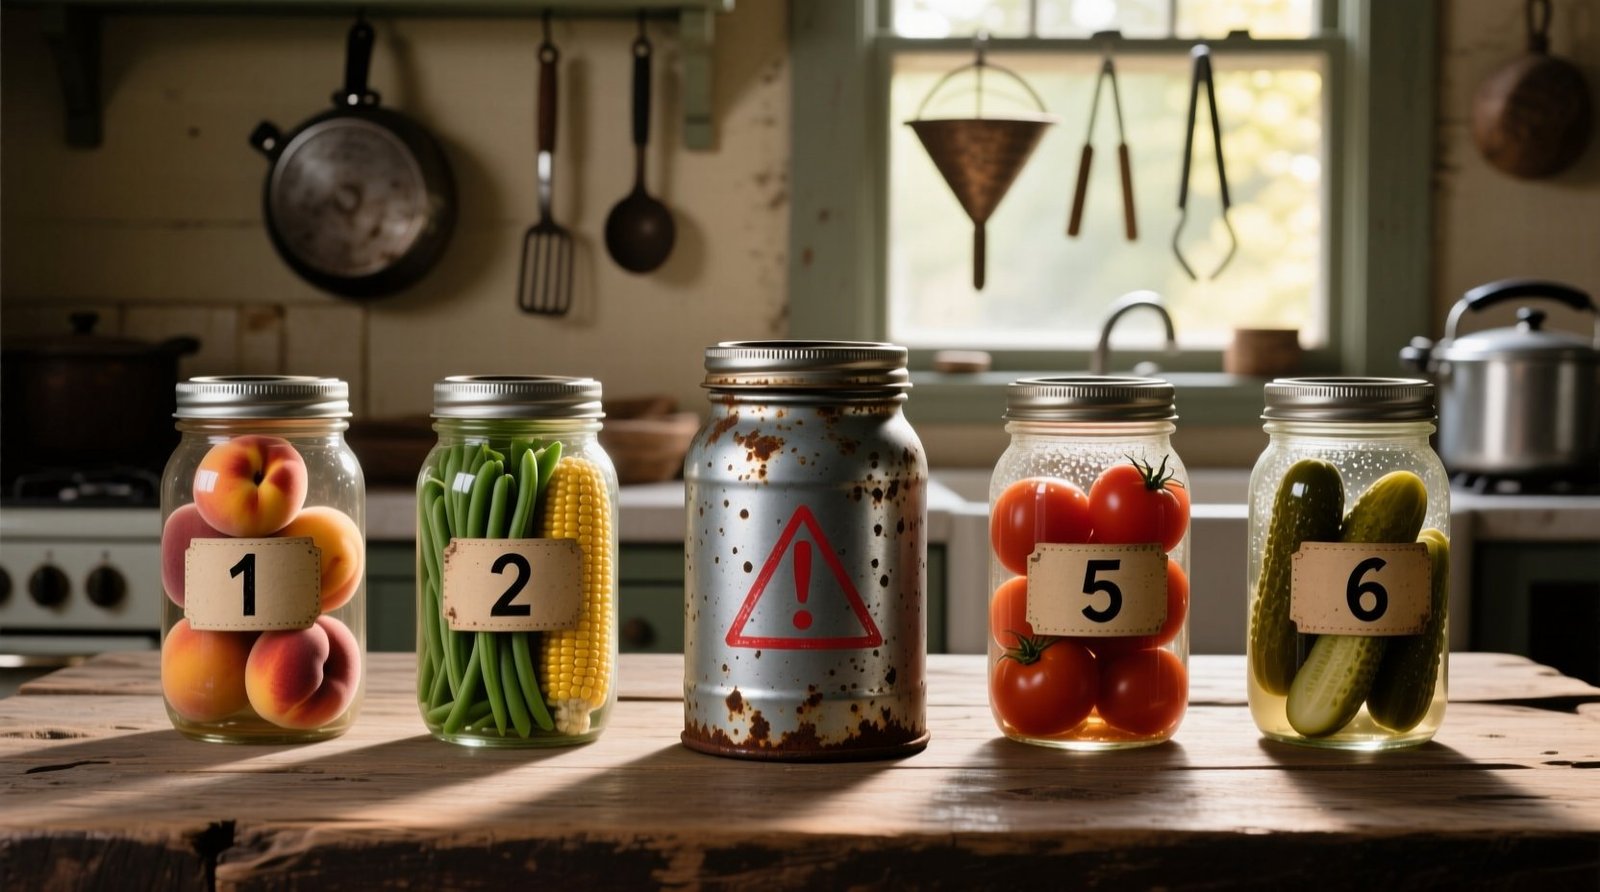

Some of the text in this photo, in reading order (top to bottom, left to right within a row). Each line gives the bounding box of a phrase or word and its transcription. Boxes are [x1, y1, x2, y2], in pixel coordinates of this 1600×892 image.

[229, 553, 256, 617] 1
[490, 552, 532, 617] 2
[1081, 558, 1123, 624] 5
[1346, 557, 1389, 622] 6
